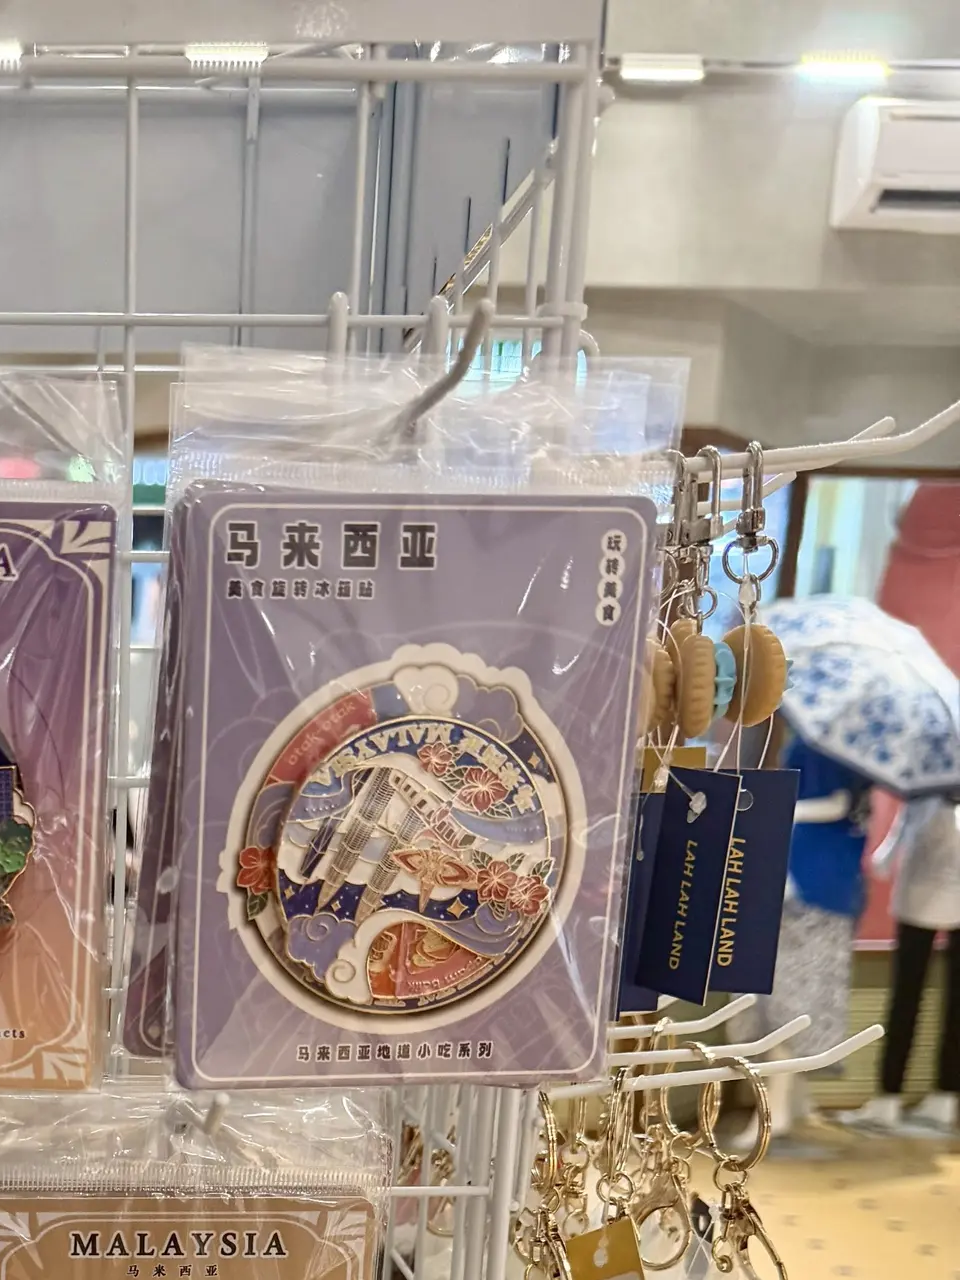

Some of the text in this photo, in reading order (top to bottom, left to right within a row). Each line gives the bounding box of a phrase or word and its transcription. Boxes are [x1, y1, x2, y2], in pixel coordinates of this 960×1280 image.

[224, 520, 438, 570] 马来西亚
[601, 534, 623, 621] 玩转美食
[668, 839, 698, 971] LAH LAH LAND
[716, 837, 747, 968] LAH LAH LAND
[296, 1041, 494, 1063] 马来西亚地道小吃系列
[68, 1229, 289, 1259] MALAYSIA
[126, 1264, 219, 1279] 马来西亚
